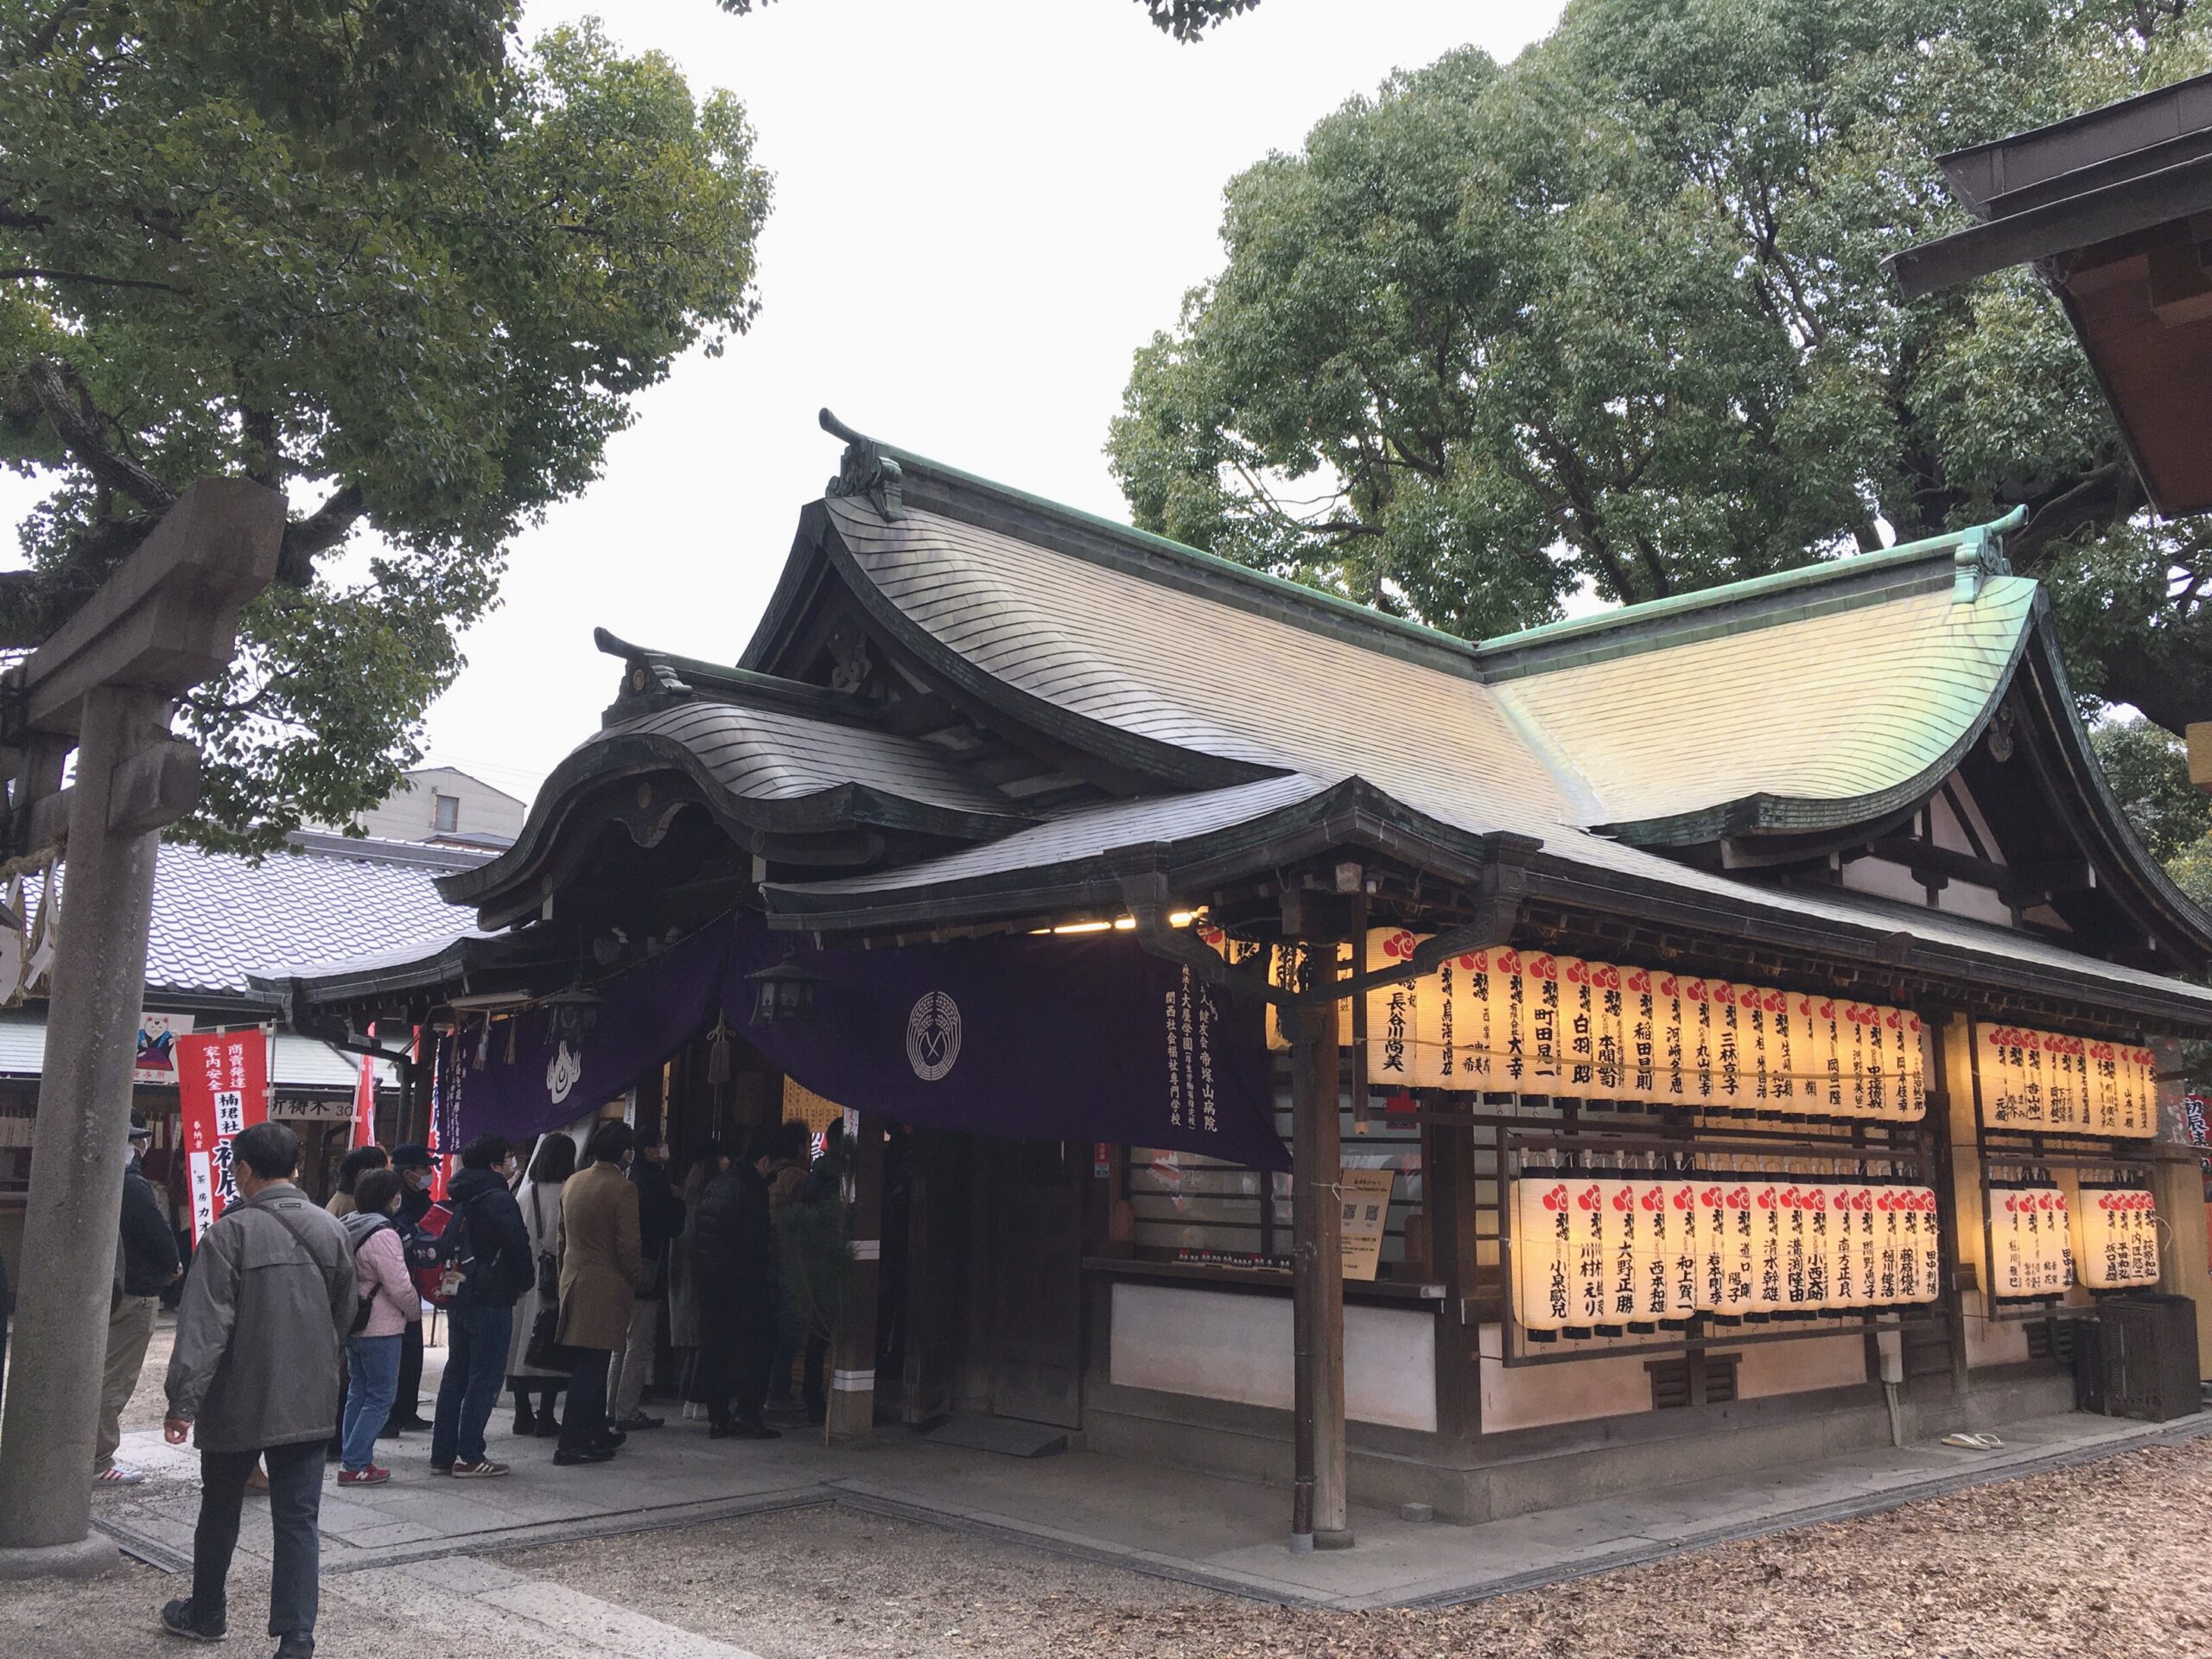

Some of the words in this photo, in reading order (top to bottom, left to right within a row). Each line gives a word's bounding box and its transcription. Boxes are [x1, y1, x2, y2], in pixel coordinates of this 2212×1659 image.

[1382, 992, 1406, 1072] 長谷川尚美
[202, 1046, 224, 1091] 家内安全
[1615, 1241, 1635, 1314] 大野正勝
[1762, 1238, 1779, 1302] 清水幹雄
[1837, 1237, 1853, 1300] 南方正良
